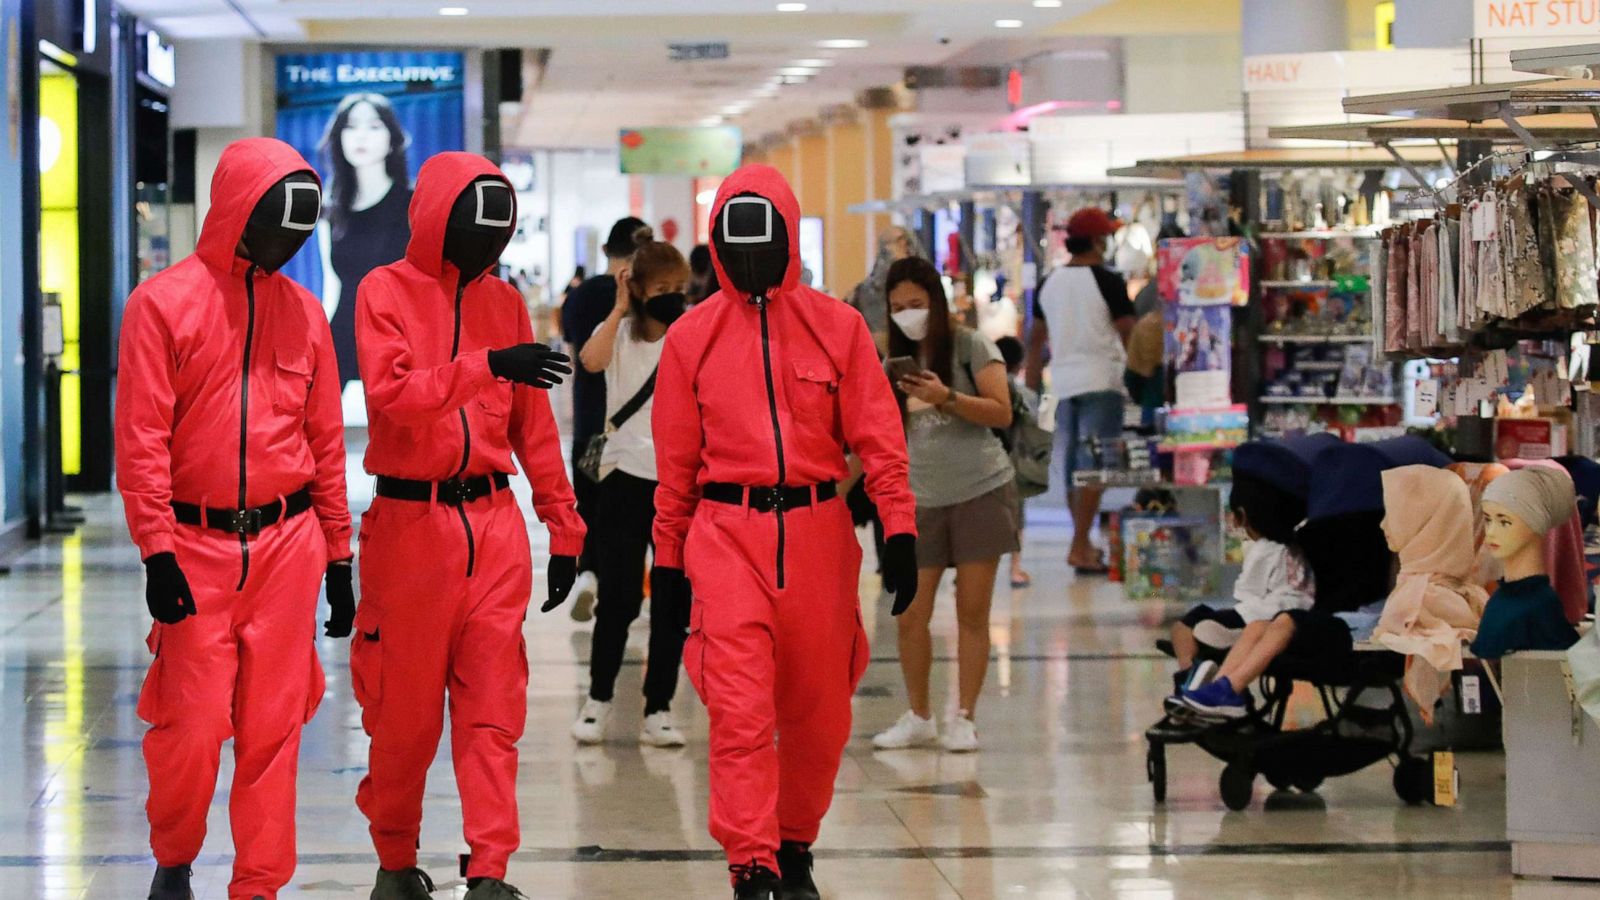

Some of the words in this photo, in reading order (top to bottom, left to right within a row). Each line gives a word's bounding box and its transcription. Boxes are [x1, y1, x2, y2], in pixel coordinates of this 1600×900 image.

[1488, 2, 1538, 27] NAT
[286, 65, 331, 82] THE
[336, 64, 455, 82] EXECUTIVE
[1247, 63, 1301, 82] HAILY
